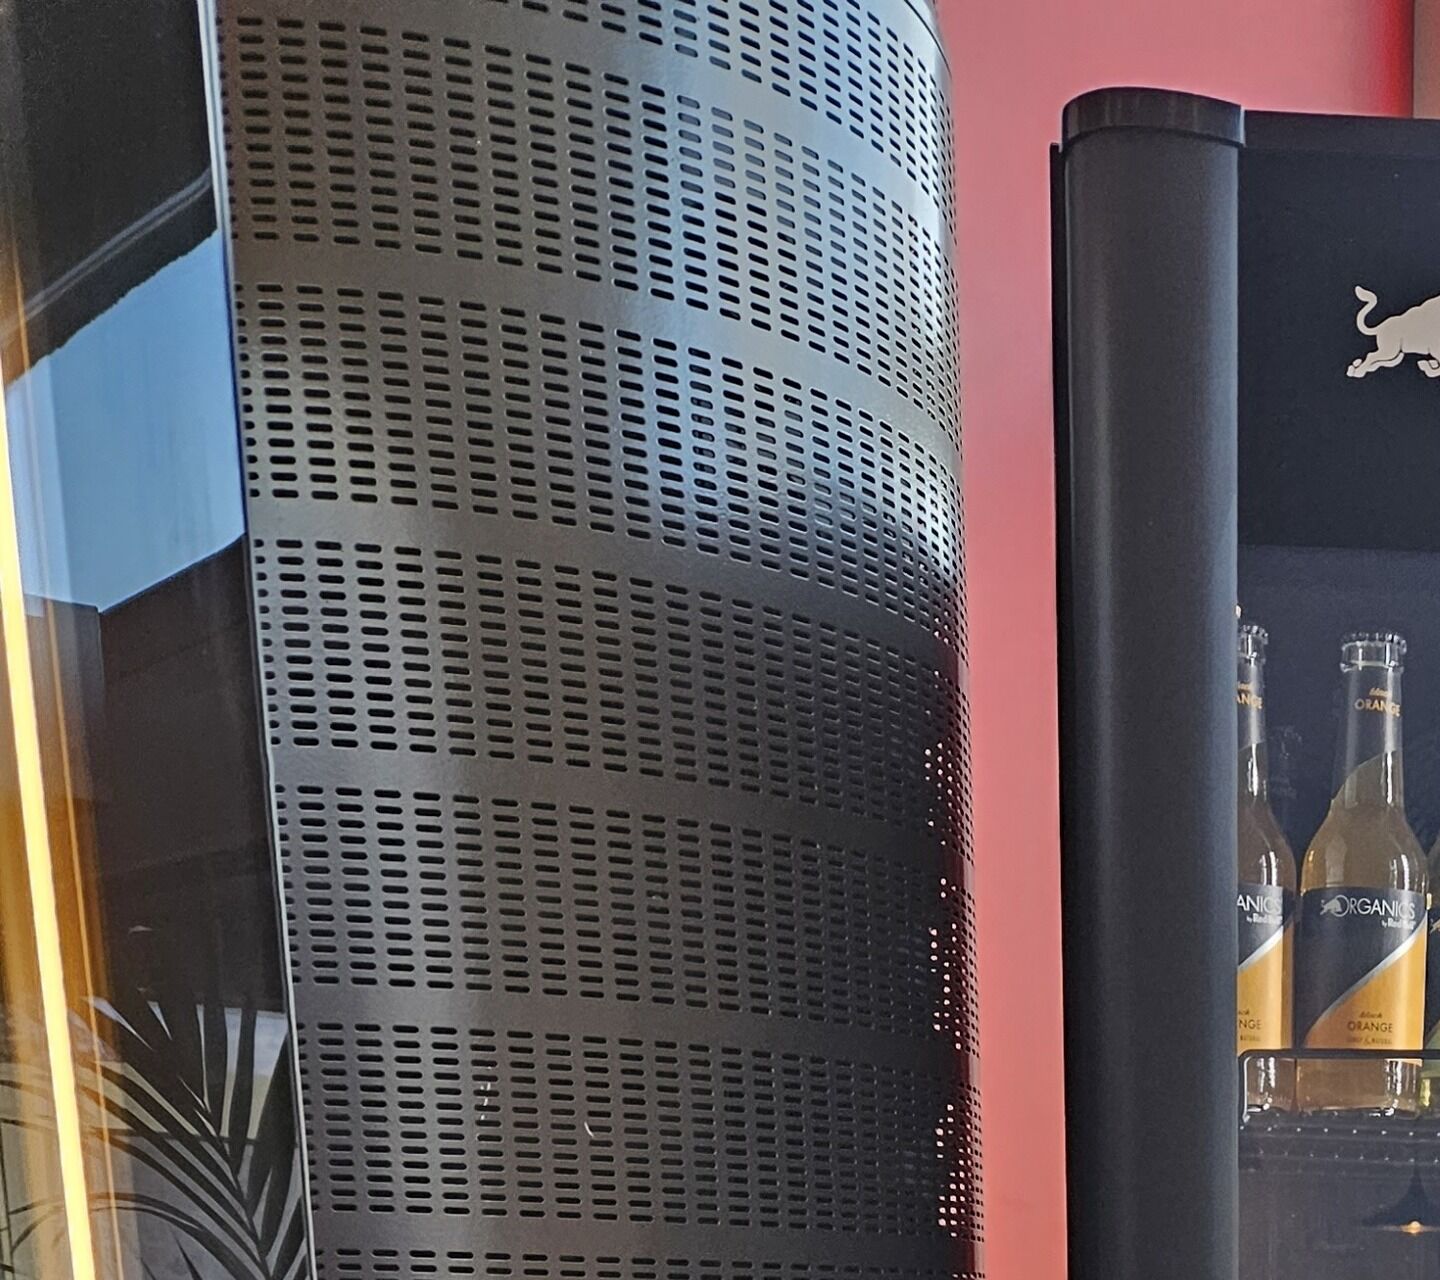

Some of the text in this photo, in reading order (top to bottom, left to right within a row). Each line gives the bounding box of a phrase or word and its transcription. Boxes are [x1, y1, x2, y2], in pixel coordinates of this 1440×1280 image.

[1354, 698, 1401, 718] ORANGE
[1236, 894, 1283, 915] ANICS
[1334, 895, 1416, 920] ORGANICS
[1238, 1019, 1263, 1030] NGE
[1346, 1020, 1394, 1033] ORANGE
